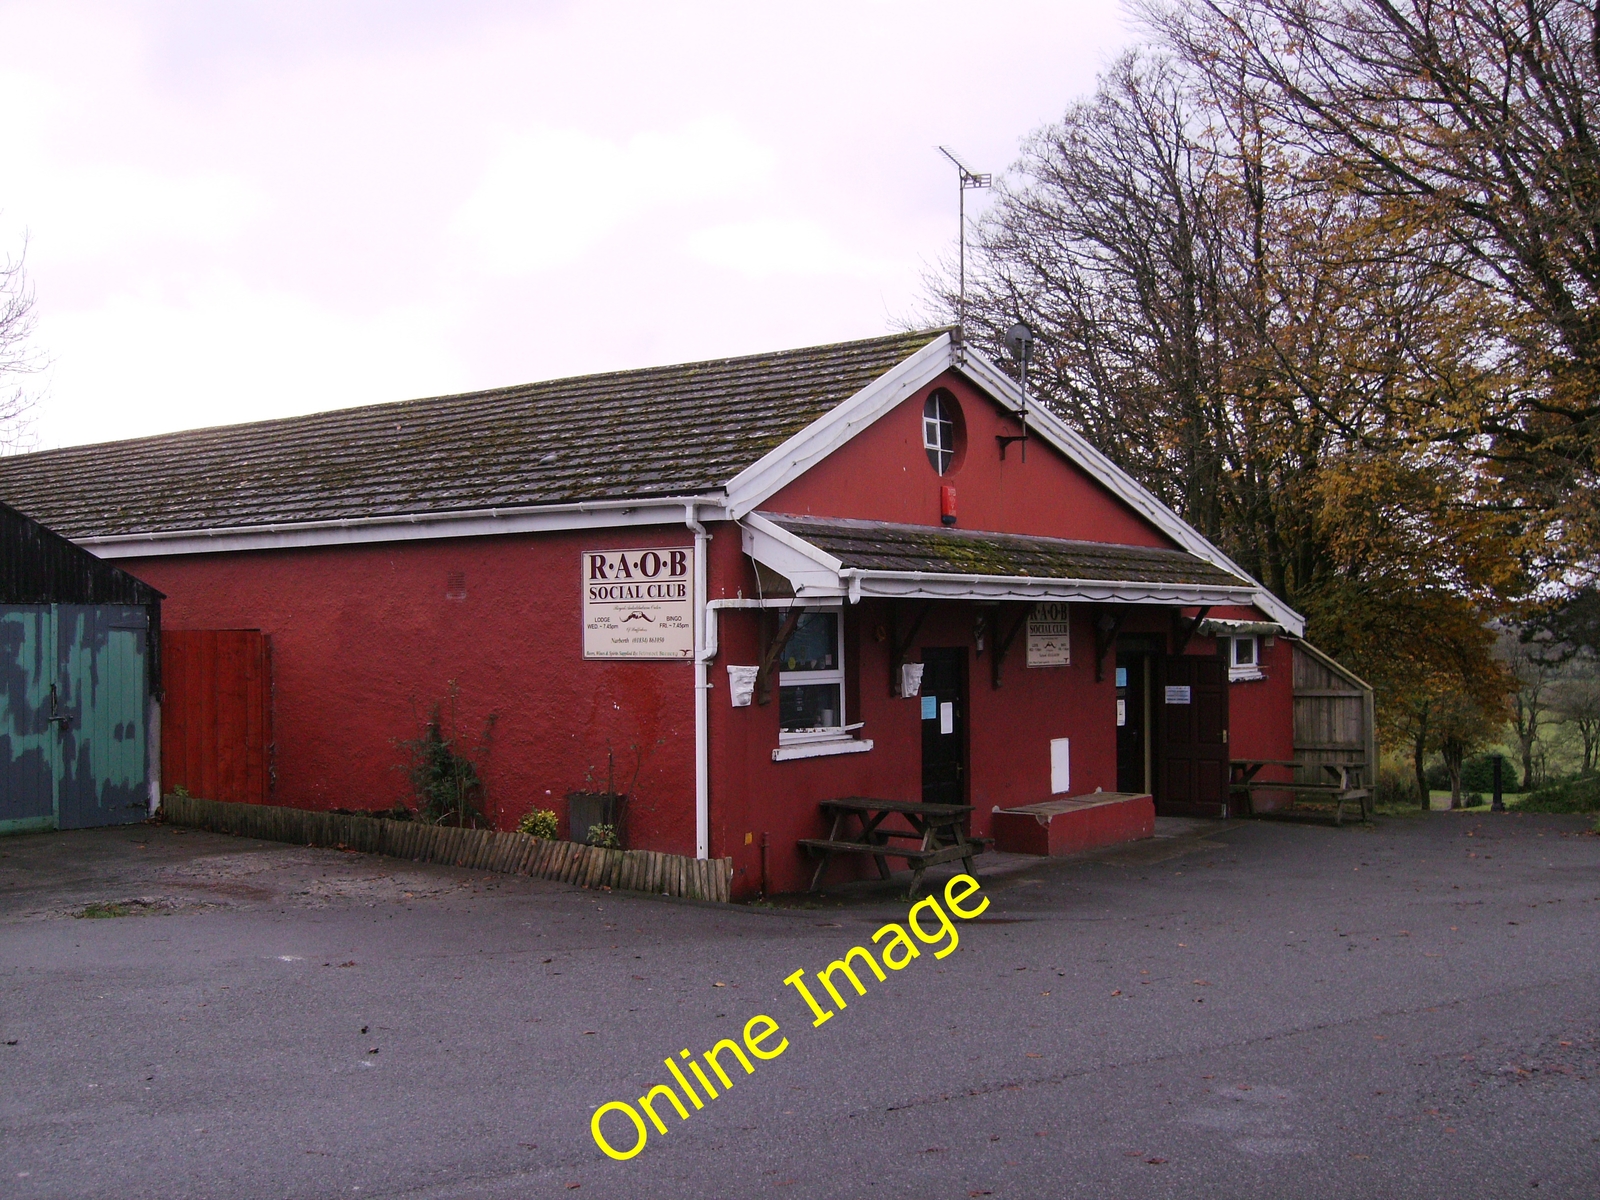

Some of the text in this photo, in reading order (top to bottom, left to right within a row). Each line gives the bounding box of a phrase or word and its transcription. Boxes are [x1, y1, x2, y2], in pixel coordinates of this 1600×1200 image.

[589, 583, 686, 600] SOCIAL CLUB
[1030, 624, 1067, 634] SOCIAL CLUB
